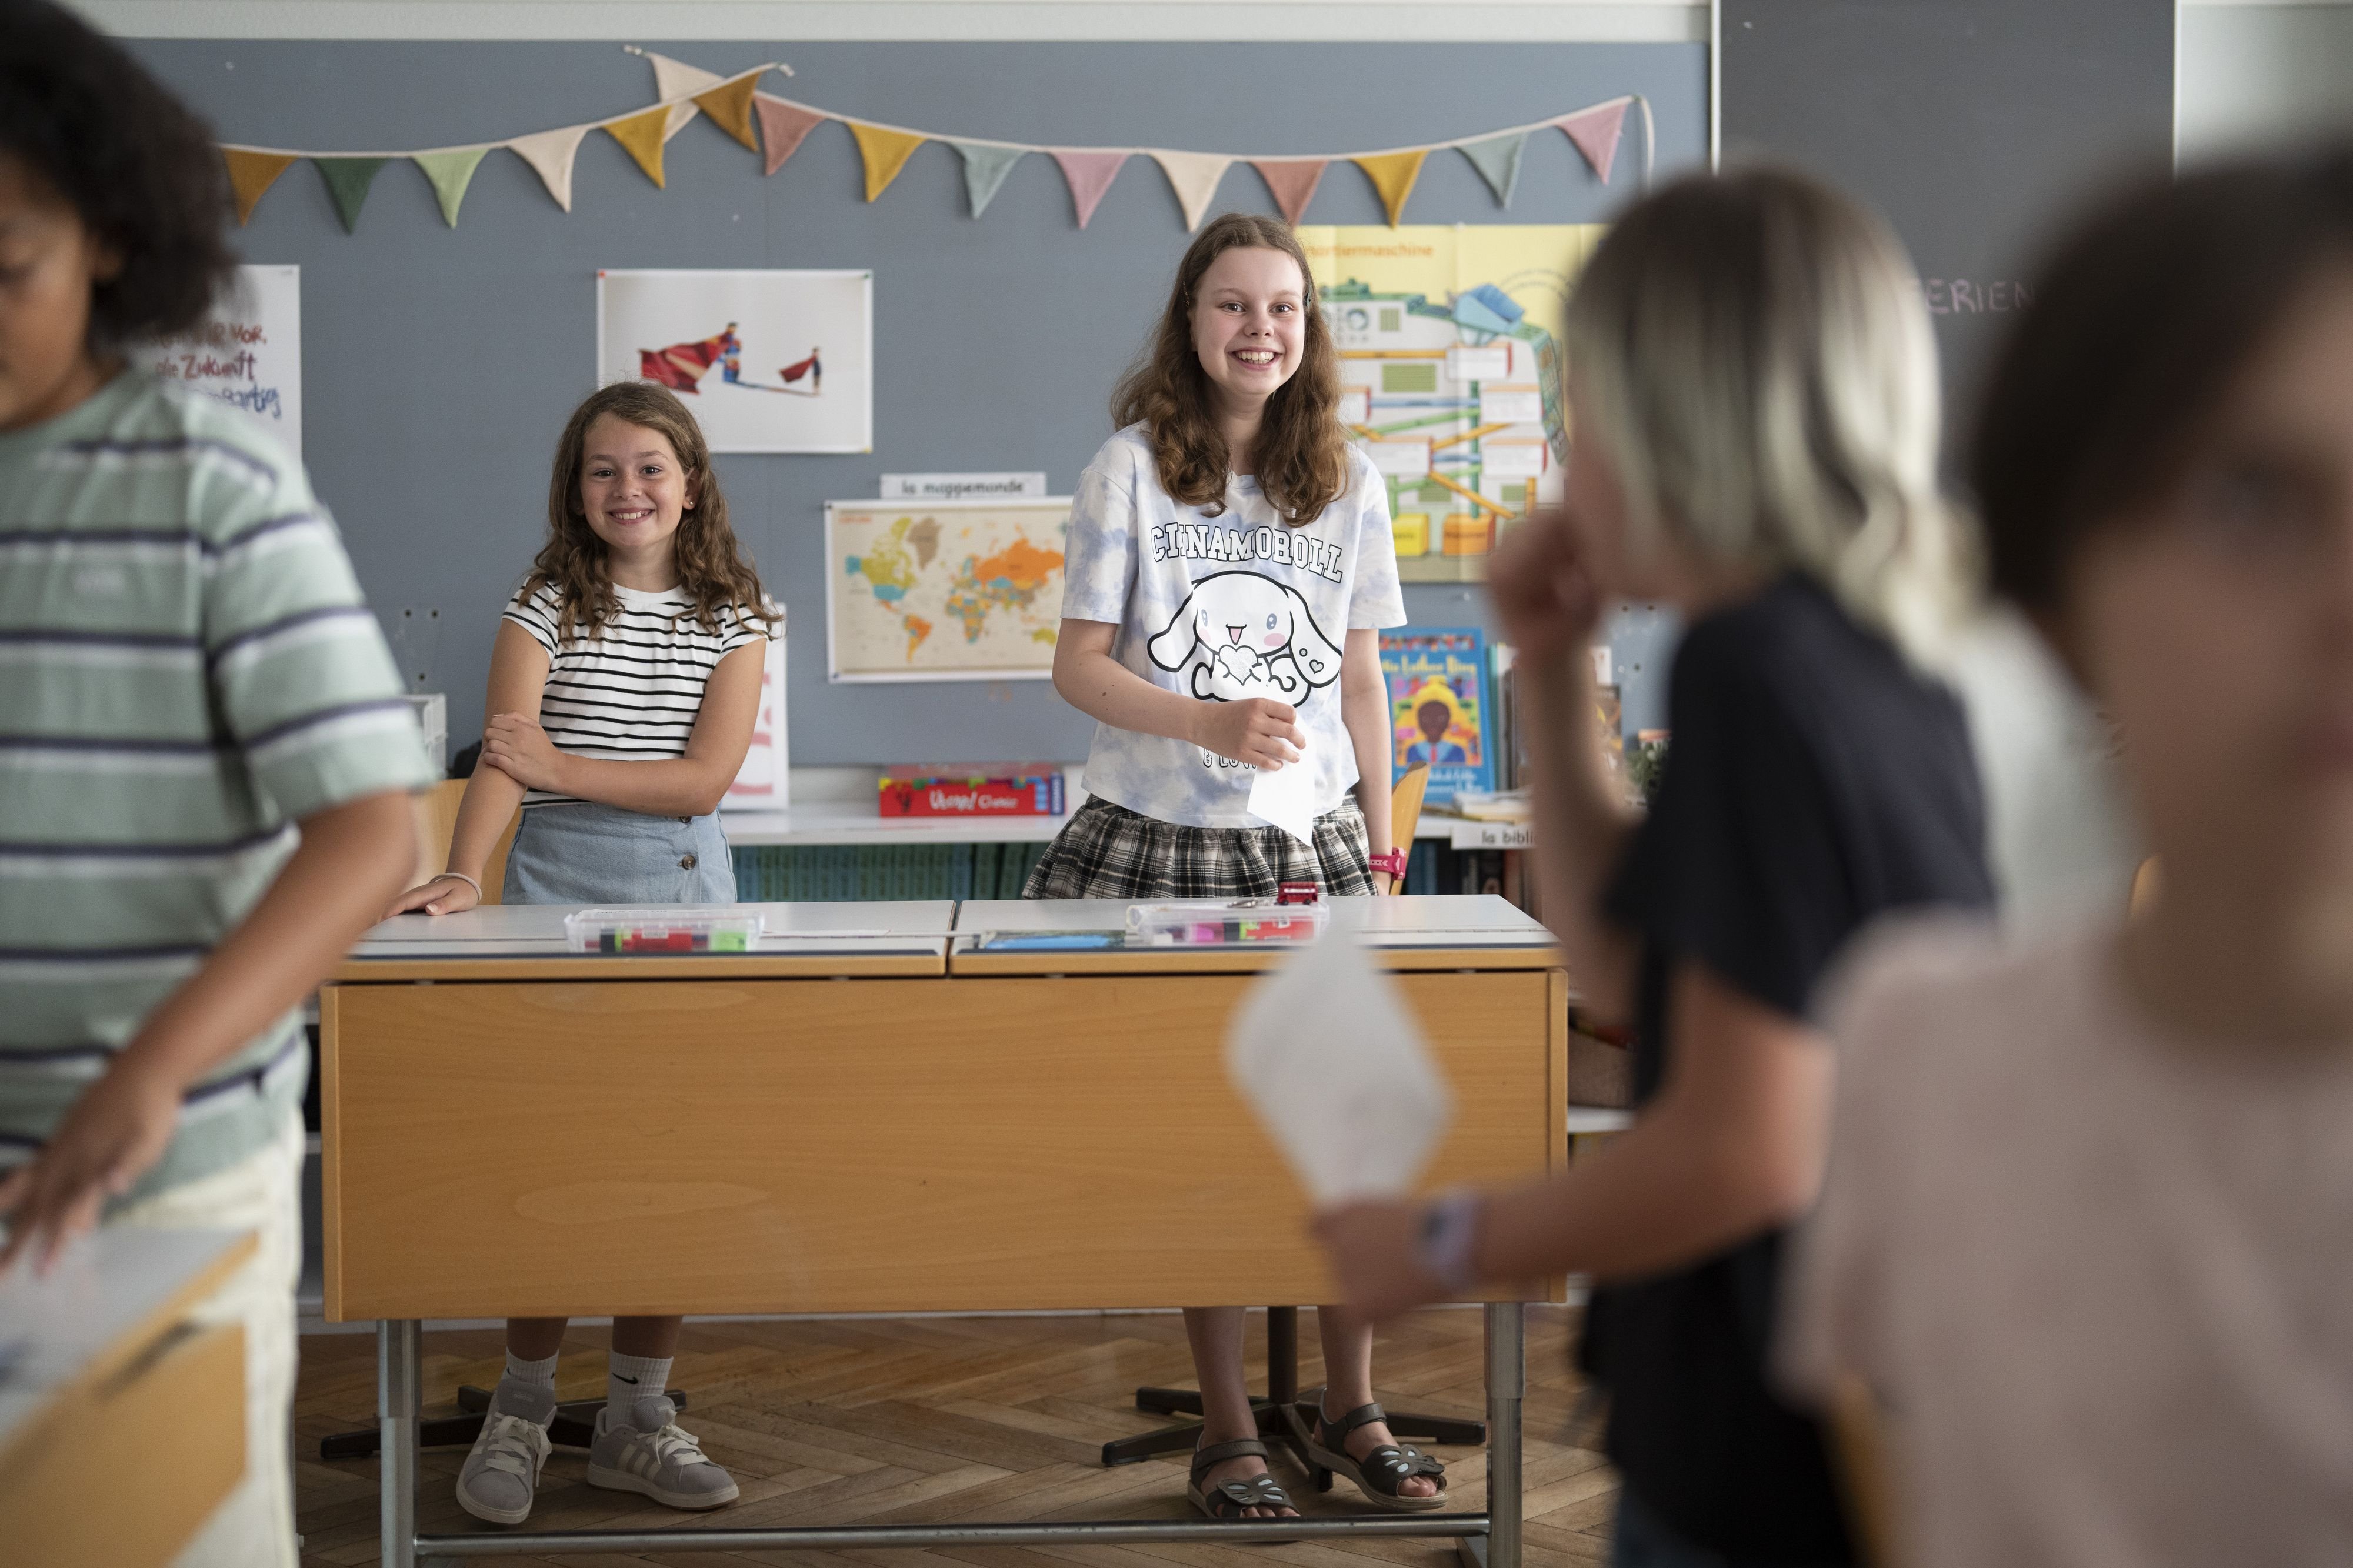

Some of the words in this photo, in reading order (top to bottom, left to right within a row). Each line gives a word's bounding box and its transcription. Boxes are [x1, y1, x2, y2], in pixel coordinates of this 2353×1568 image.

[1922, 278, 2034, 315] ERIEN
[179, 350, 256, 381] Zukunft
[1482, 829, 1495, 844] la
[1502, 829, 1534, 844] bibli
